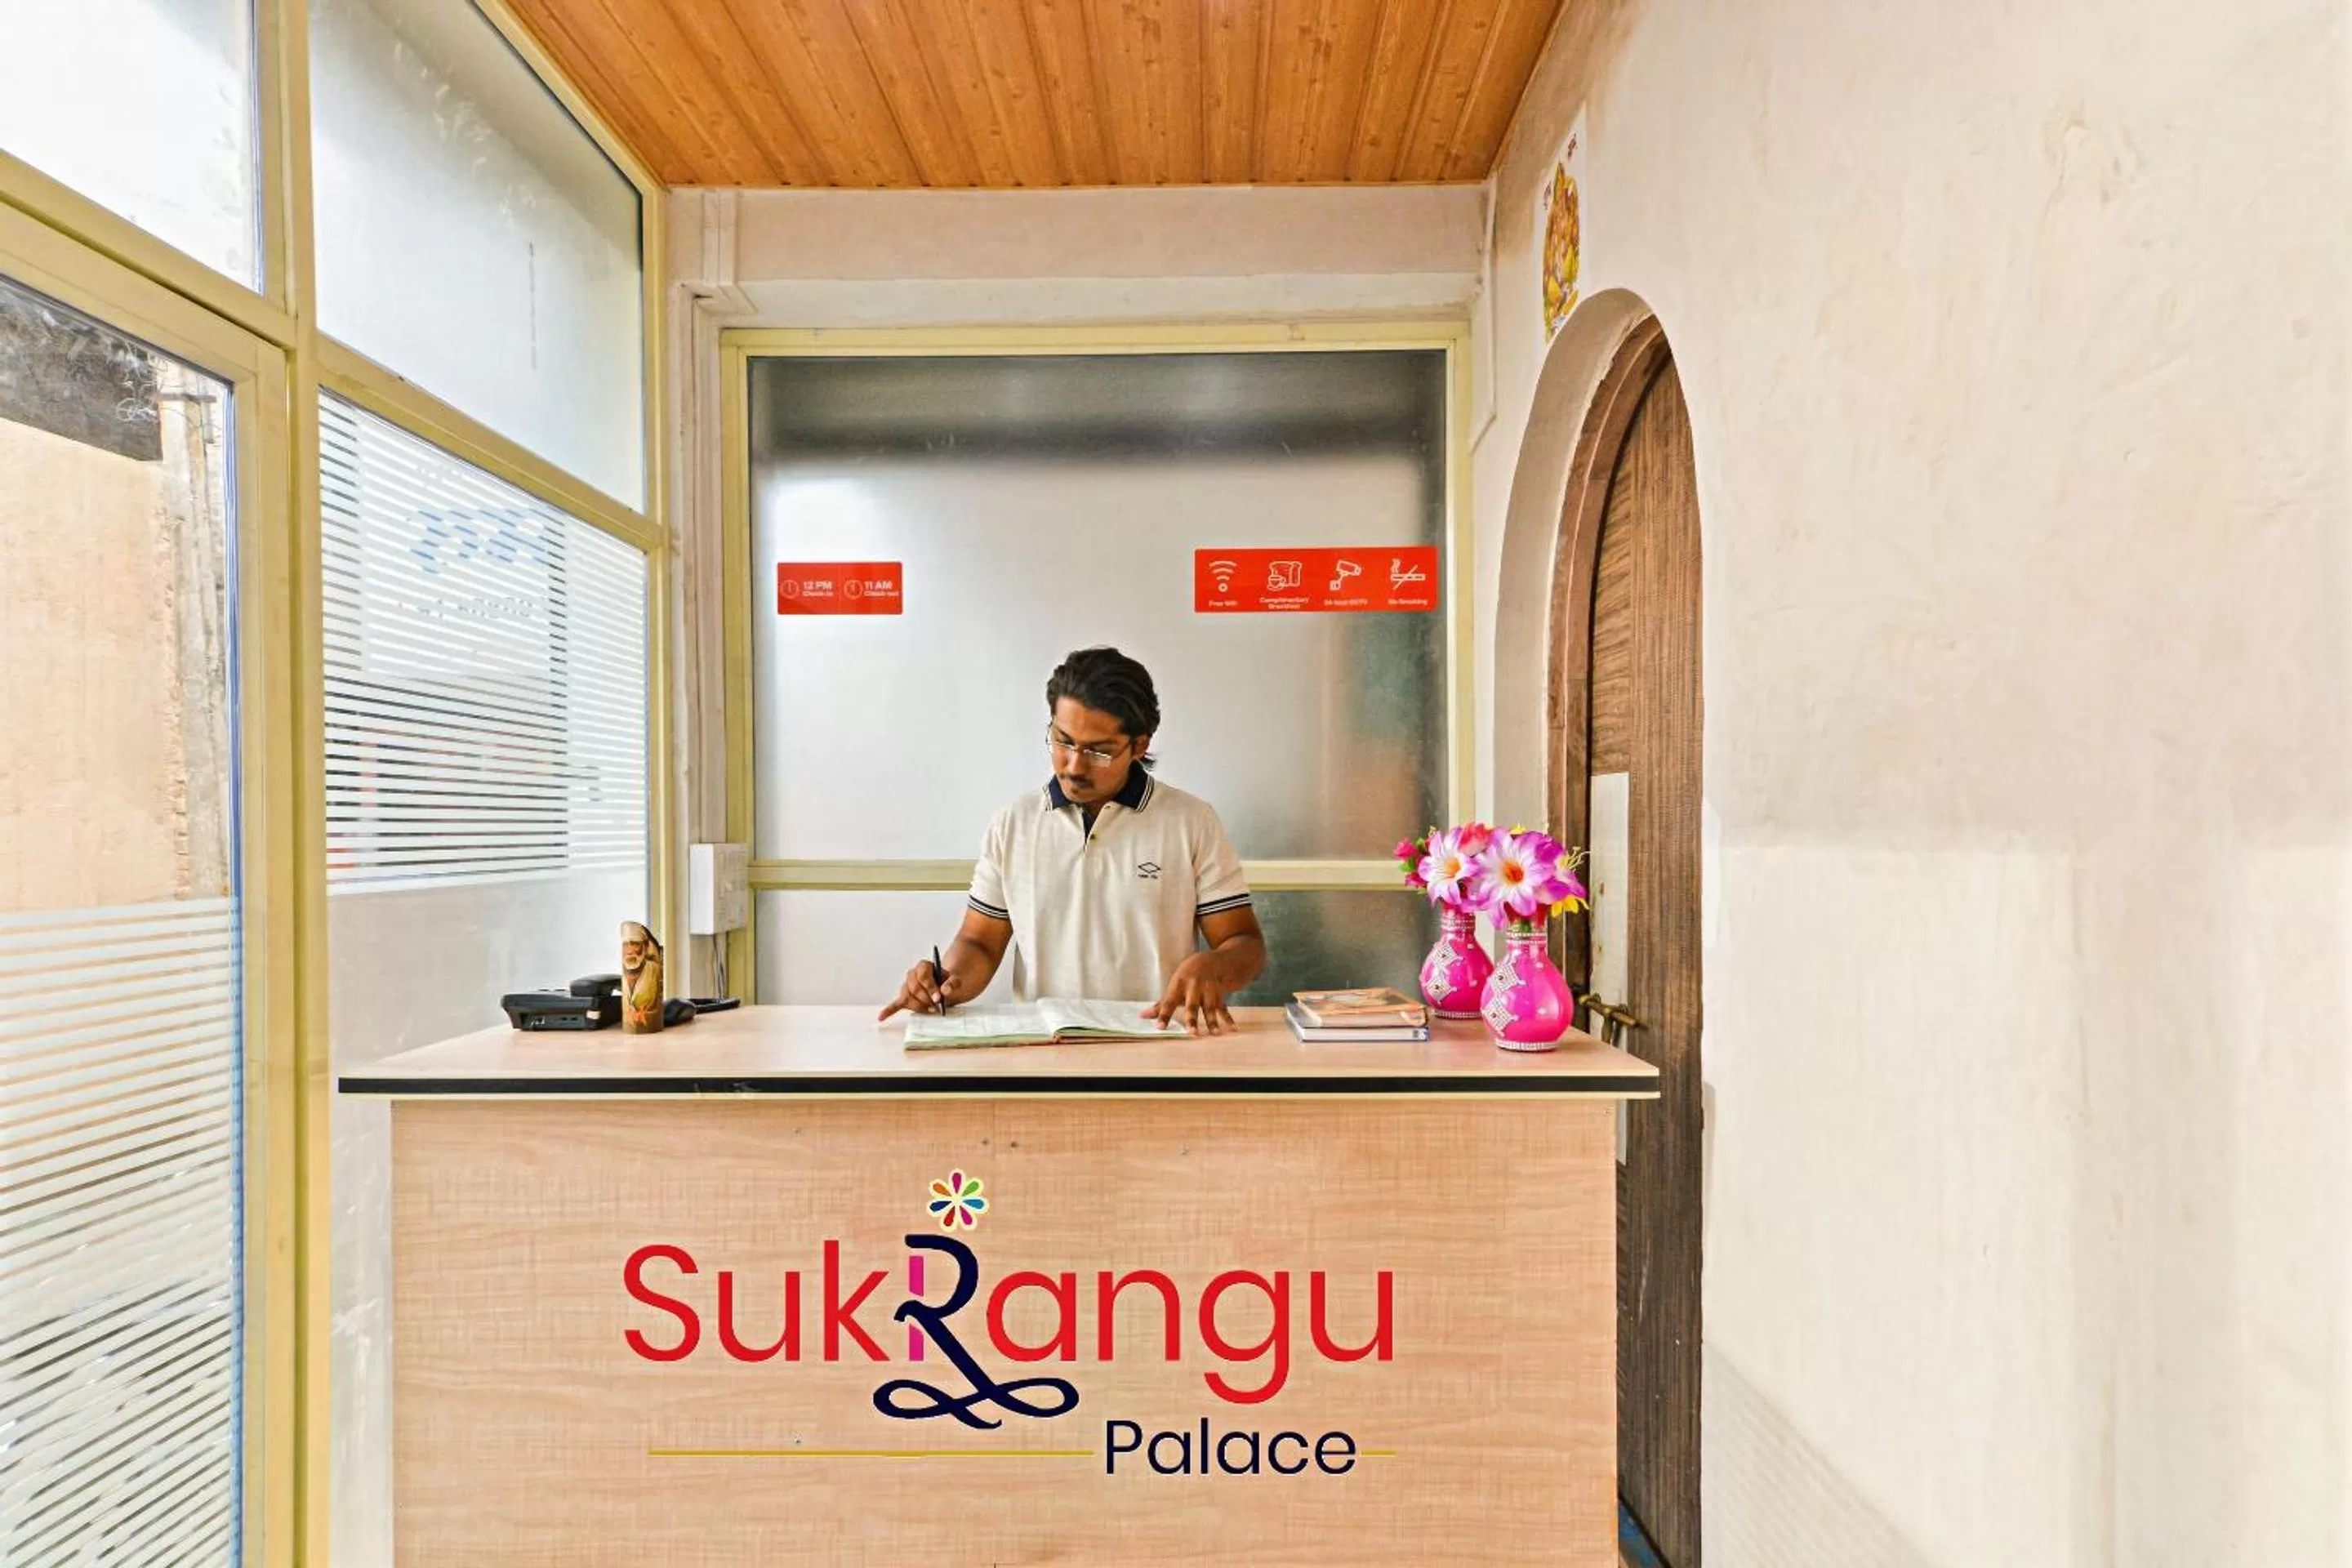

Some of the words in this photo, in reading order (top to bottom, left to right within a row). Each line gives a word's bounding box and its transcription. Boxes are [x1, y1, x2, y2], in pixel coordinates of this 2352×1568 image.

[816, 581, 832, 590] PM
[875, 581, 893, 590] AM
[1105, 1417, 1357, 1475] Palace
